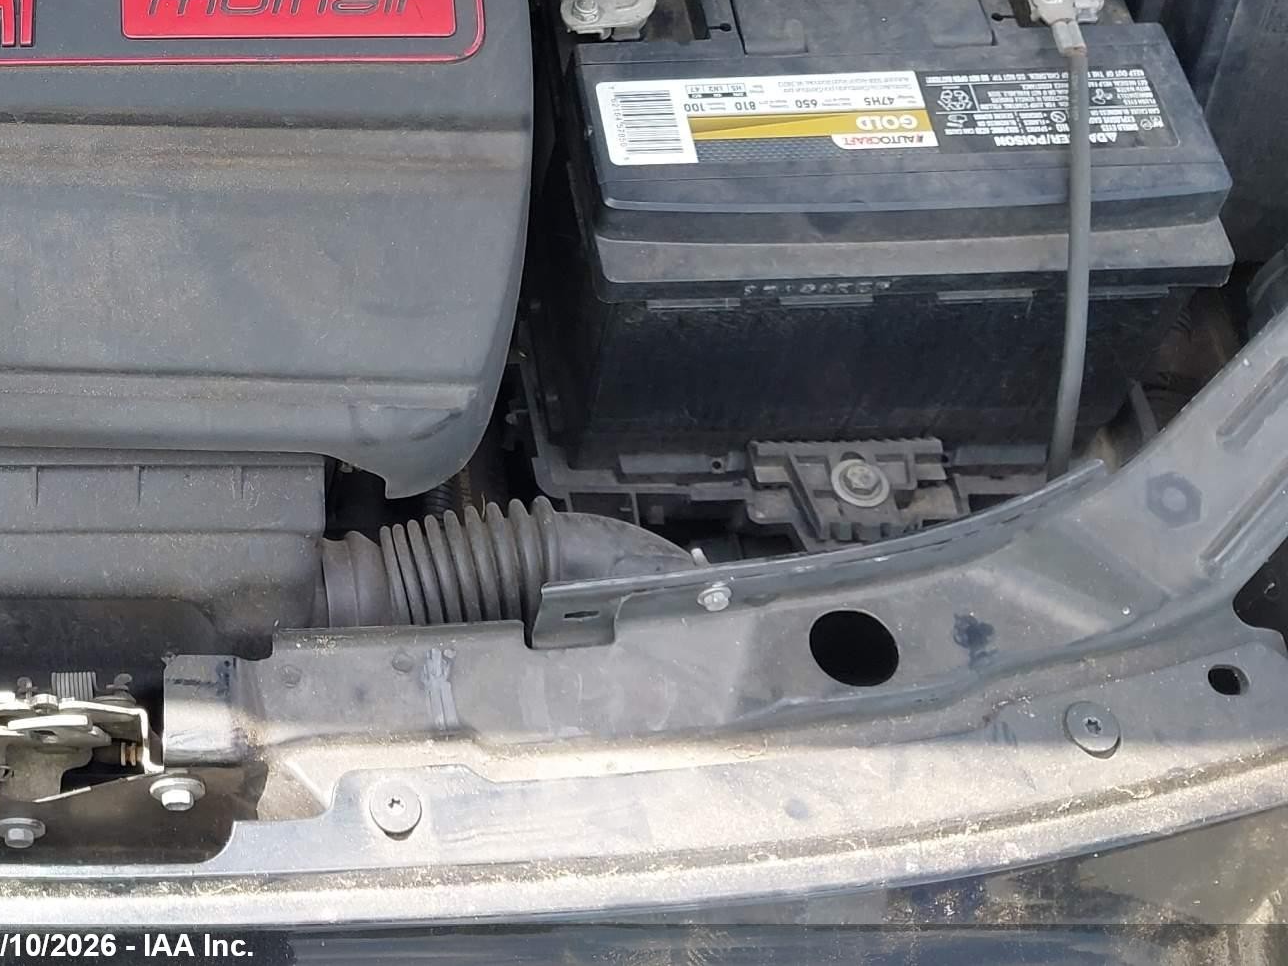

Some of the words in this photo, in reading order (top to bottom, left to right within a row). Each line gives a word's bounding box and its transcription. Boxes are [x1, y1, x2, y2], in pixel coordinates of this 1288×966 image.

[734, 101, 757, 111] 810
[794, 99, 818, 109] 650
[863, 96, 895, 107] 47H5
[683, 103, 705, 113] 100
[855, 114, 918, 131] GOLD
[843, 135, 916, 146] AUTOCRAFT
